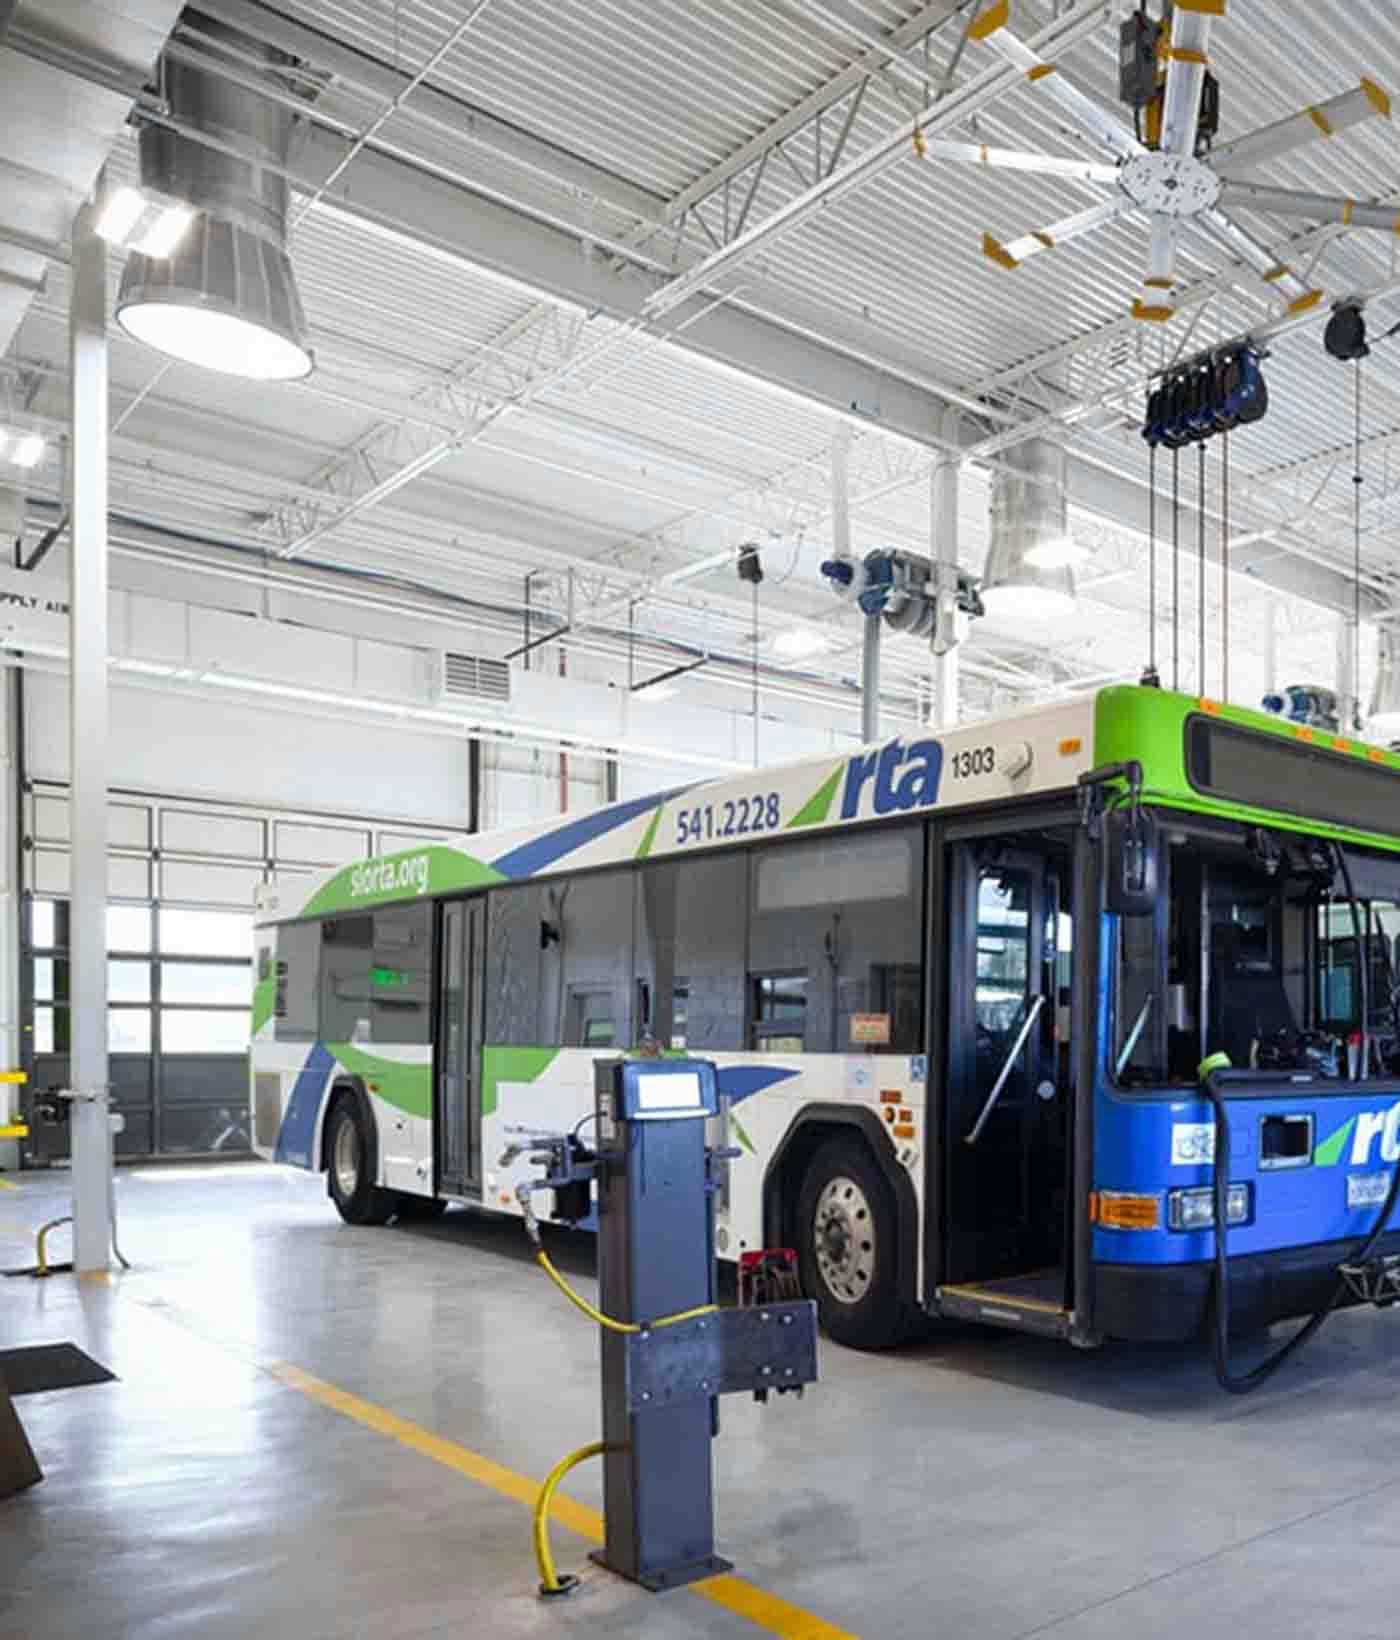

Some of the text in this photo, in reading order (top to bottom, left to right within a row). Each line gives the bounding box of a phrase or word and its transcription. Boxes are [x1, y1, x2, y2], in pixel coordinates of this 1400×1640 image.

[839, 736, 995, 820] rta 1303
[676, 792, 780, 844] 541.2228
[351, 856, 430, 897] slorta.org
